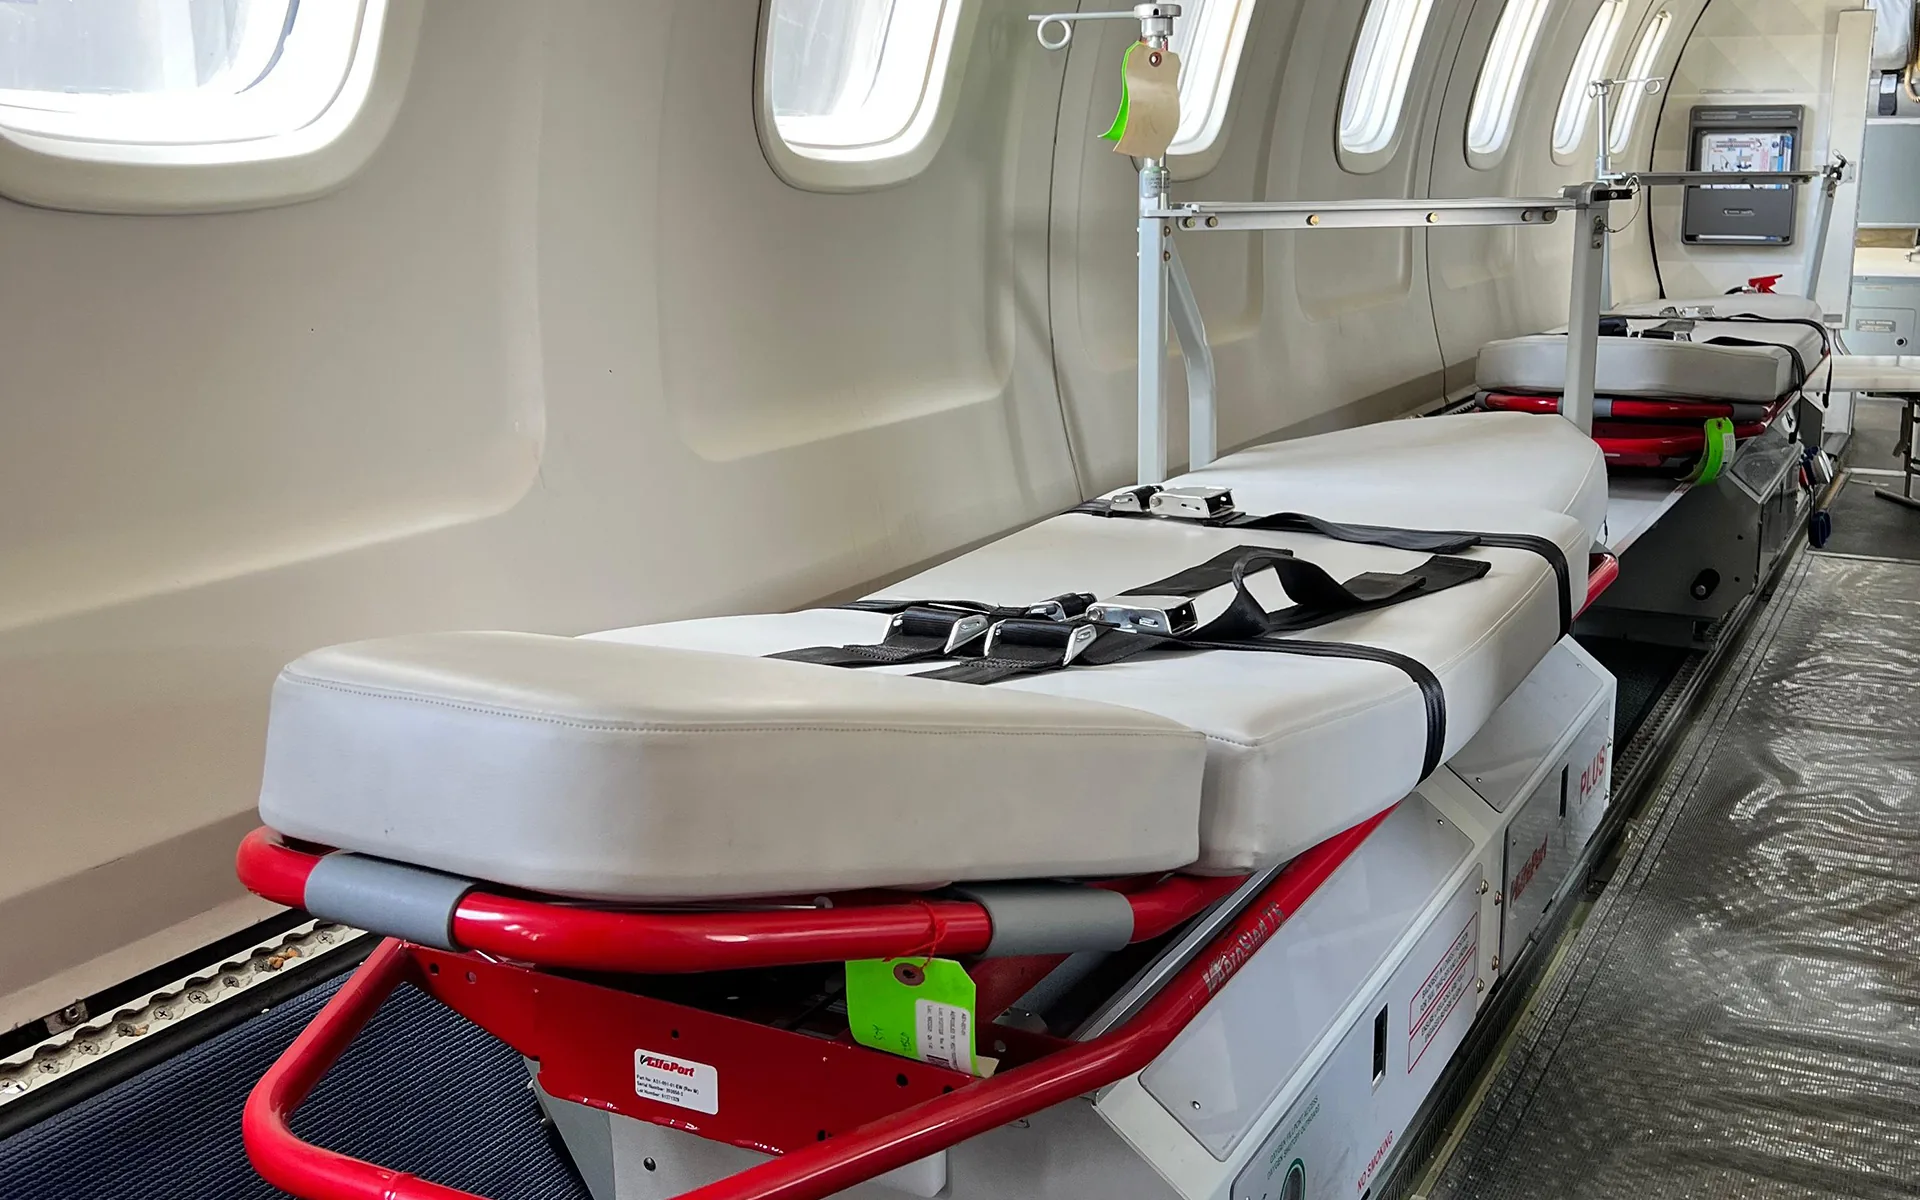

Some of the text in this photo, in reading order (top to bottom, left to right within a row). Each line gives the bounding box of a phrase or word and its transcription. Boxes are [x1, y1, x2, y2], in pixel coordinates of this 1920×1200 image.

[1580, 745, 1606, 805] PLUS
[646, 1056, 694, 1077] LifePort
[1367, 1130, 1393, 1178] SMOKING
